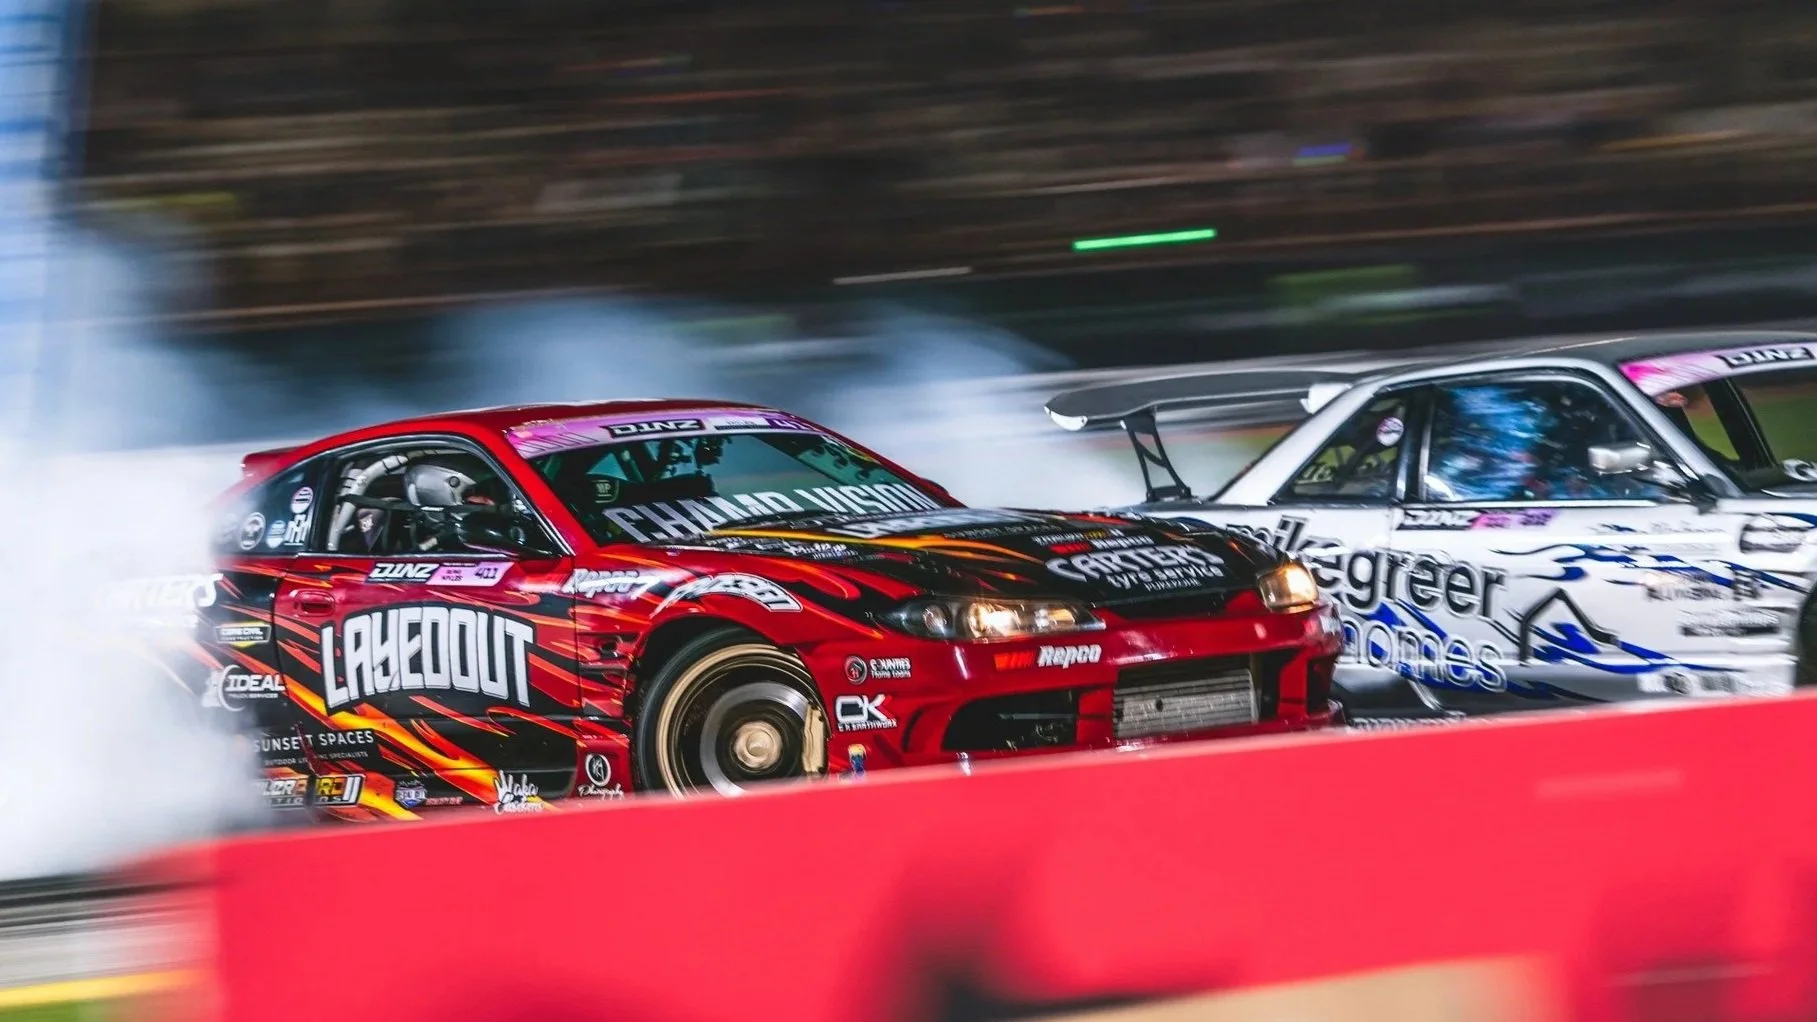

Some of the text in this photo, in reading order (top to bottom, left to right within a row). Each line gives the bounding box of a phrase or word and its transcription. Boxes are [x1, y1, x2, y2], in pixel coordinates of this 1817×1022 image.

[793, 483, 942, 515] VISION
[321, 606, 534, 709] LAYEDOUT
[1038, 644, 1102, 668] Repco
[225, 674, 286, 692] IDEAL
[319, 730, 375, 746] SPACES
